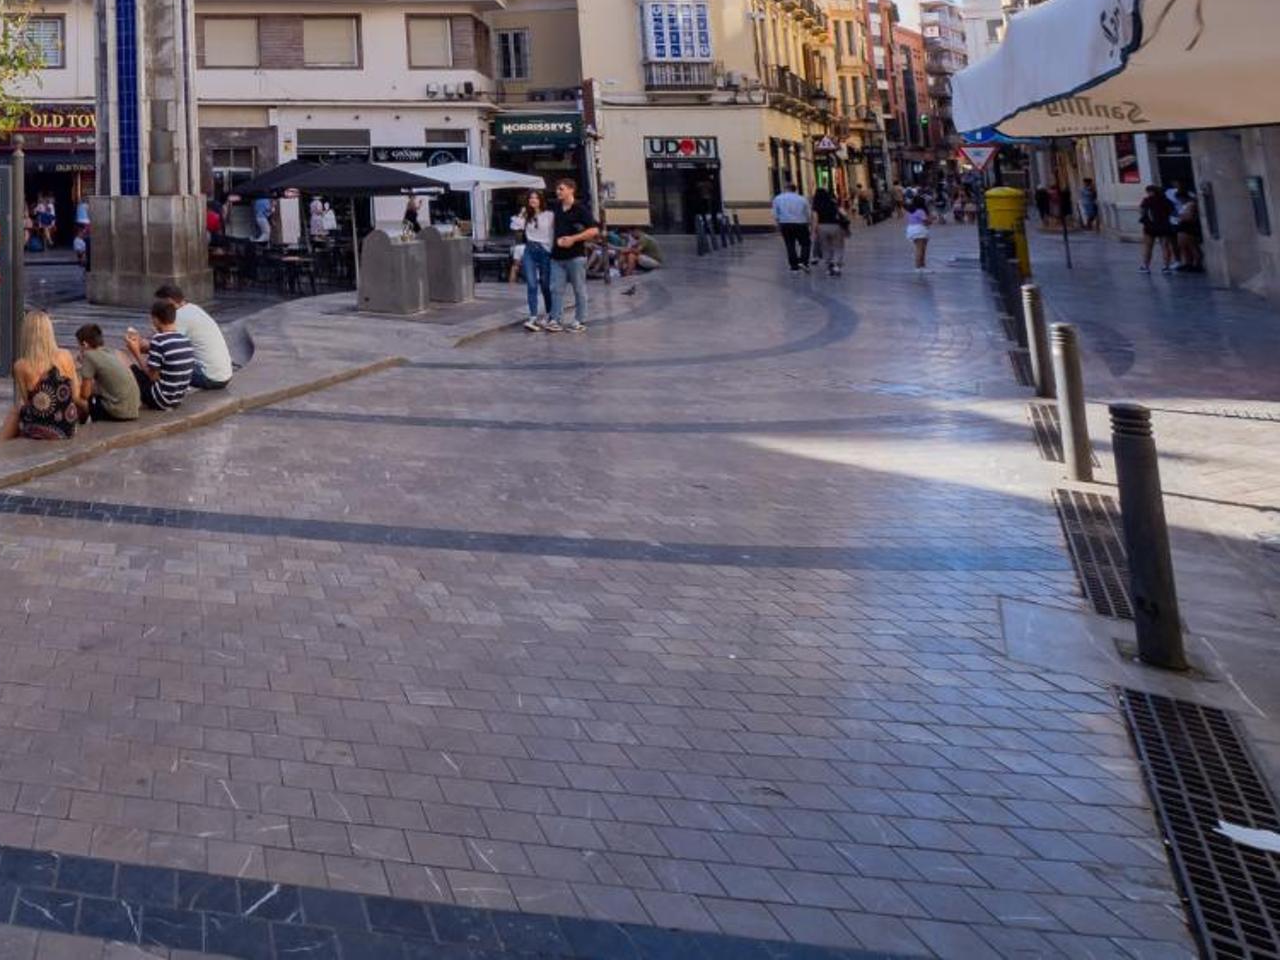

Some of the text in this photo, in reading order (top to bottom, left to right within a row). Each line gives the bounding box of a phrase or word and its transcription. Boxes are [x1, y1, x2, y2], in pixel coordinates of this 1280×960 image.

[30, 114, 96, 128] OLD TO
[650, 138, 713, 156] UDON
